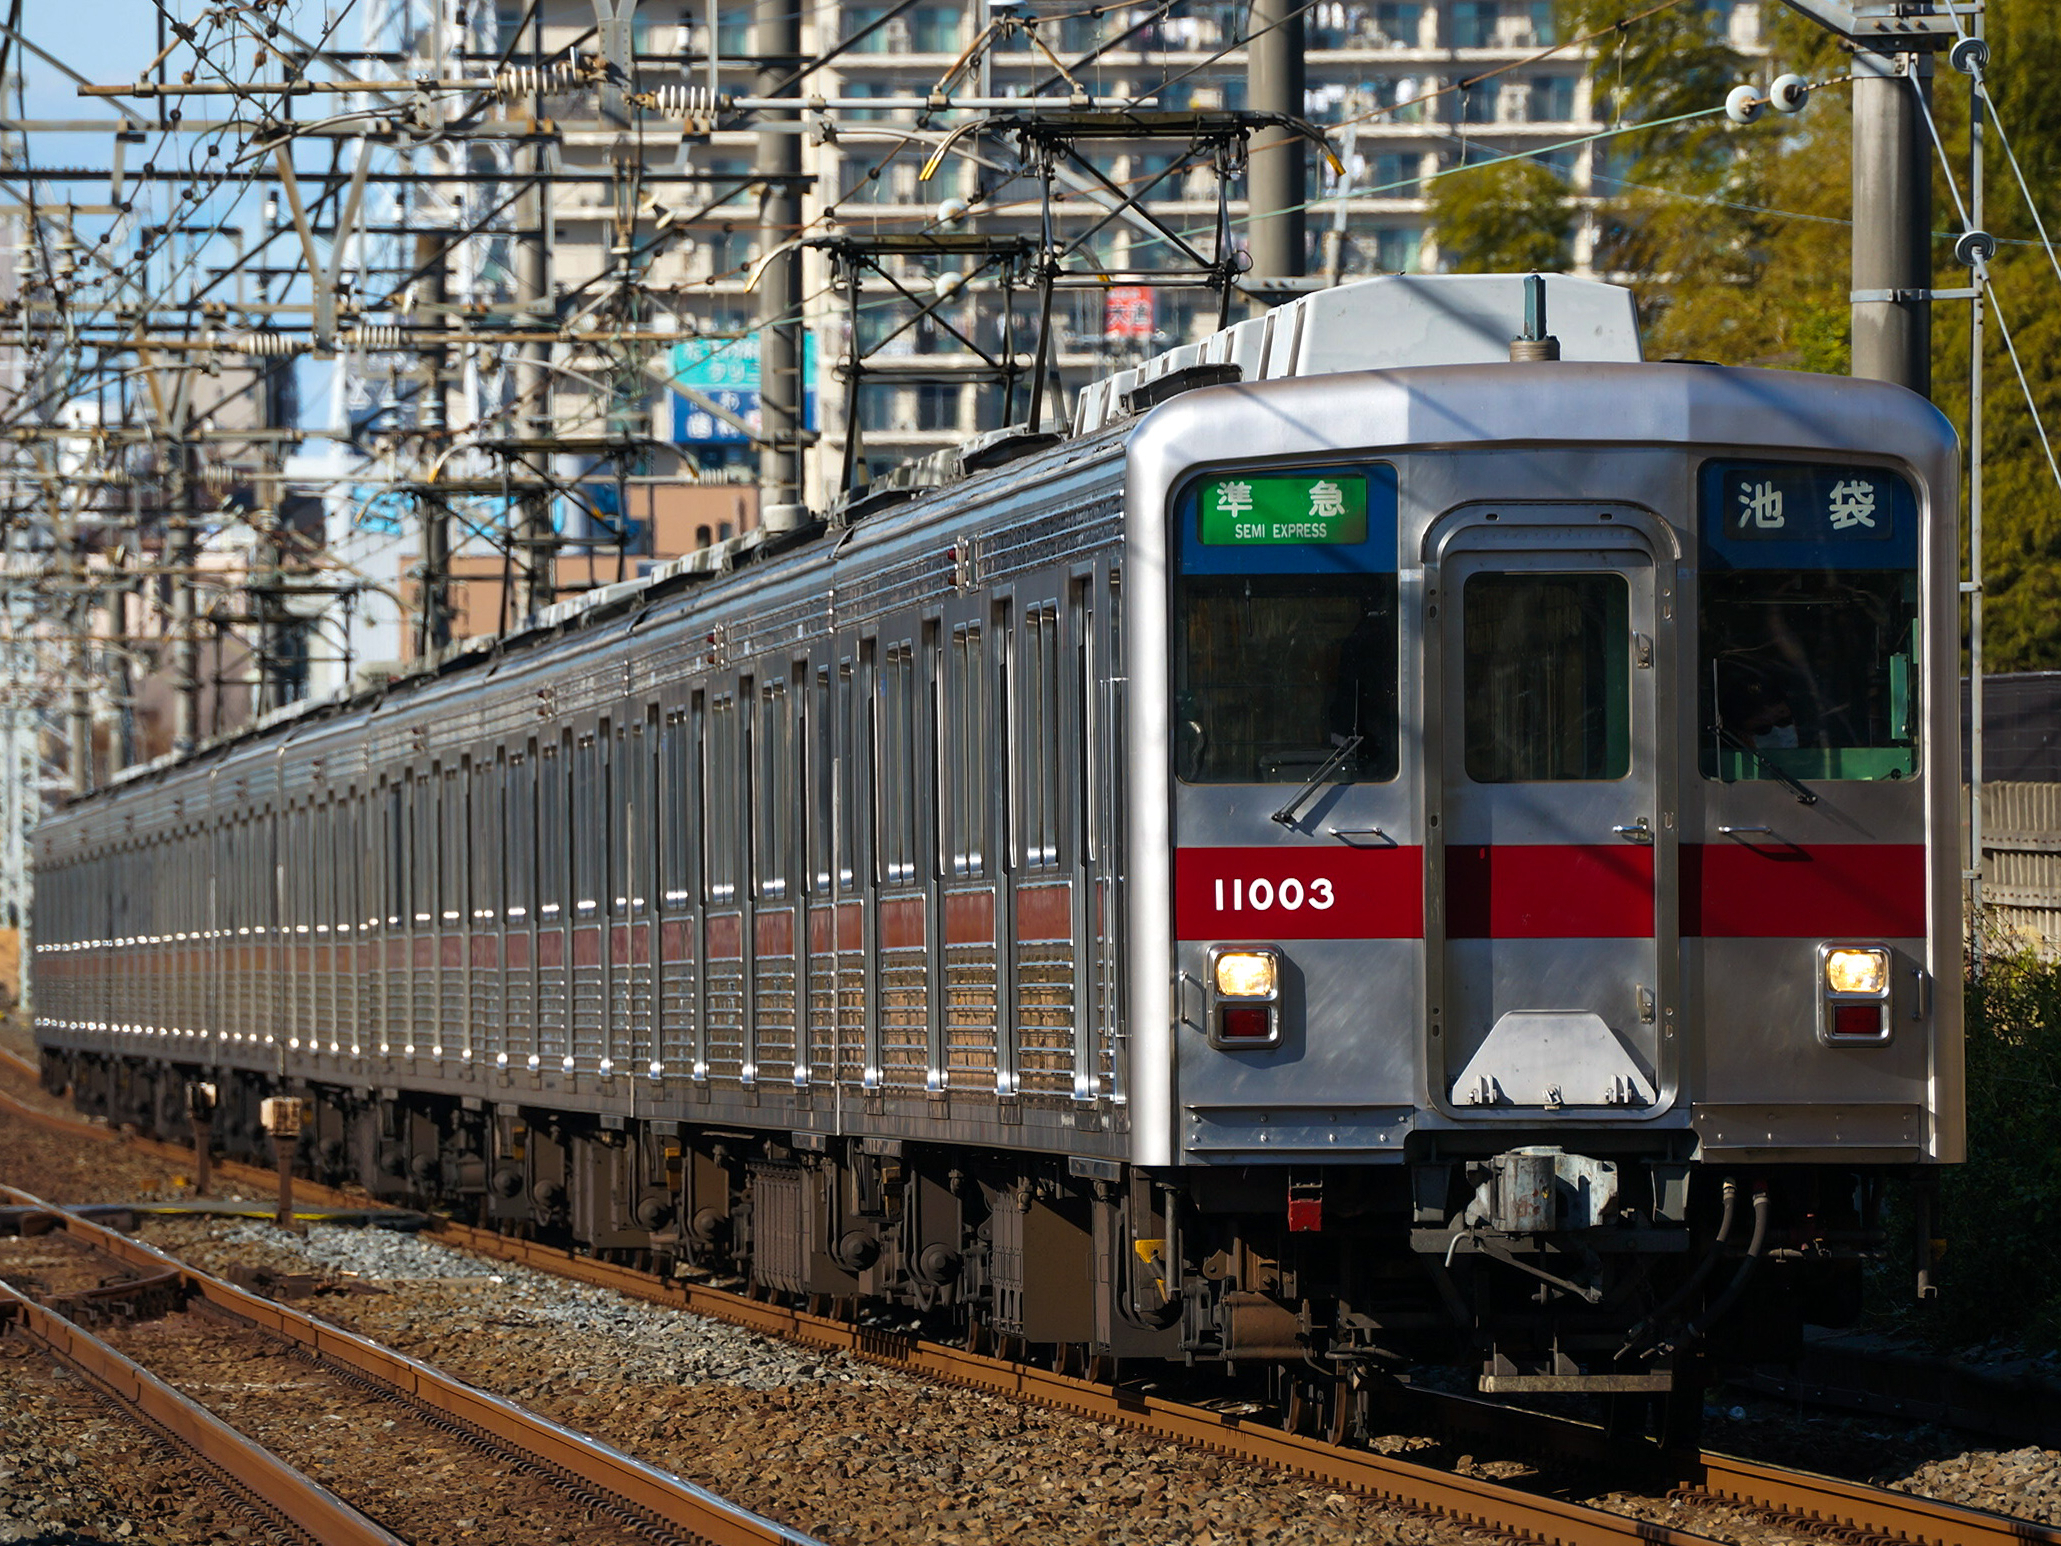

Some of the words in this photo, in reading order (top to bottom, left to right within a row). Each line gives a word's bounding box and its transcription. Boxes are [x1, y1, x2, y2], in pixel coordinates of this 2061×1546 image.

[1234, 523, 1266, 539] SEMI
[1272, 523, 1327, 538] EXPRESS
[1214, 877, 1335, 911] 11003
